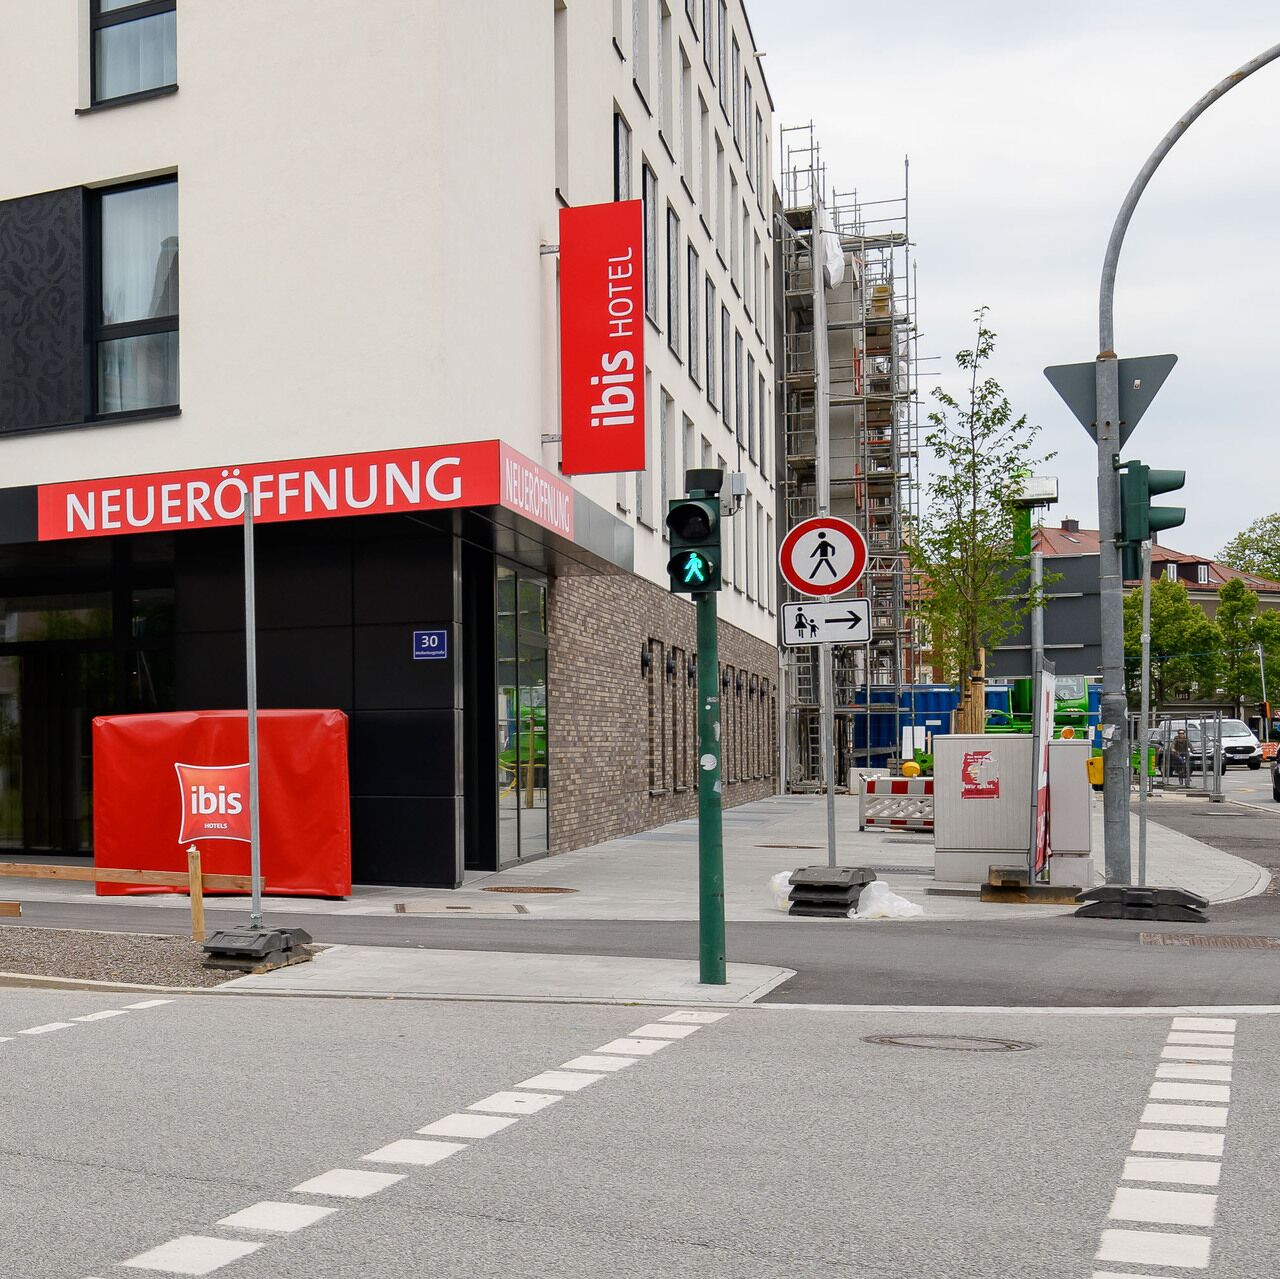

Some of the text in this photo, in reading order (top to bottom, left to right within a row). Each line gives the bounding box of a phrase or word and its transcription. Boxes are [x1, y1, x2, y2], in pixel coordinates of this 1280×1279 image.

[591, 246, 634, 427] ibis HOTEL
[66, 456, 462, 533] NEUERÖFFNUNG
[506, 458, 570, 533] NEUERÖFFNUNG
[421, 635, 438, 648] 30
[191, 785, 243, 815] ibis
